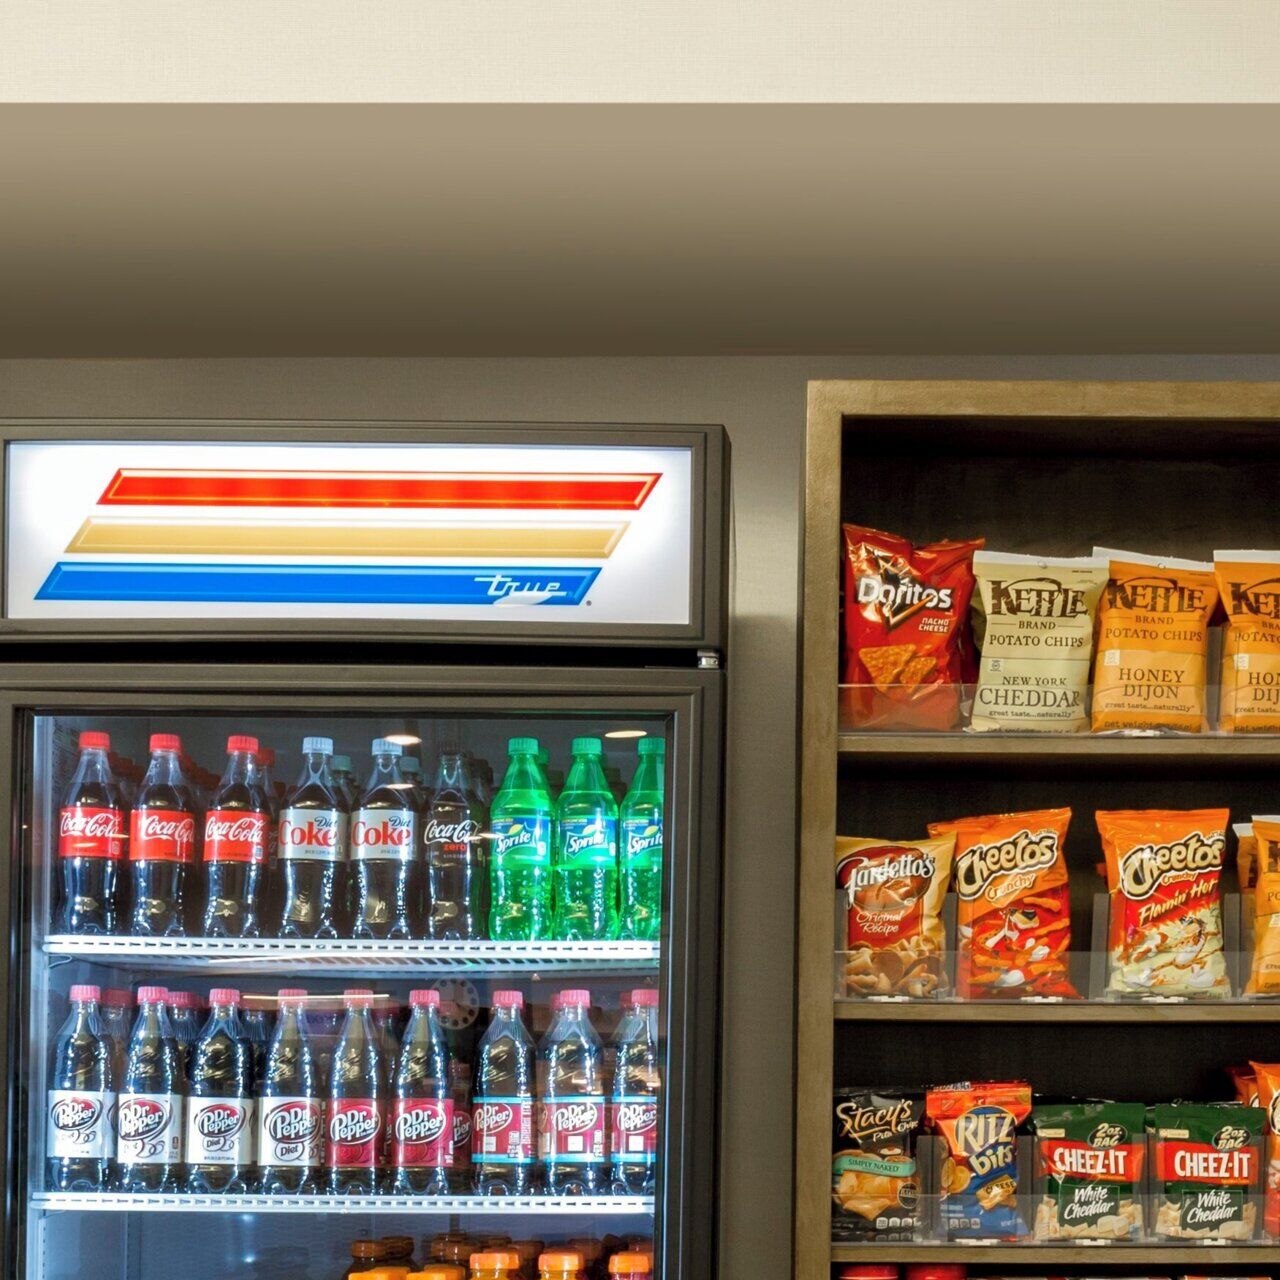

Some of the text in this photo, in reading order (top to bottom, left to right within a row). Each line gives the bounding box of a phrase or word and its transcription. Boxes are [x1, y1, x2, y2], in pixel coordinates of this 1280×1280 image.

[858, 576, 952, 609] Doritos
[1104, 578, 1207, 617] KETTLE
[918, 624, 949, 633] CHEESE
[1019, 620, 1056, 630] BRAND
[1105, 628, 1202, 641] POTATO CHIPS
[989, 635, 1084, 648] POTATO CHIPS
[1003, 676, 1067, 686] NEW YORK
[1119, 668, 1185, 682] HONEY
[979, 688, 1080, 708] CHEDDAR
[1124, 684, 1179, 698] DIJON
[278, 819, 337, 847] Coke
[351, 820, 410, 847] Coke
[497, 833, 531, 849] Sprite
[958, 833, 1056, 895] Cheetos
[985, 873, 1035, 901] Crunchy
[1191, 880, 1218, 900] Hot
[857, 911, 905, 925] Original
[860, 923, 899, 934] Recipe
[396, 1111, 445, 1141] Pepper
[836, 1099, 913, 1137] Stacy's
[956, 1113, 1014, 1150] RITZ
[279, 1145, 299, 1157] Diet
[970, 1145, 1014, 1176] bits
[1053, 1147, 1127, 1174] CHEEZ-IT
[1174, 1150, 1251, 1178] CHEEZ-IT
[1074, 1186, 1108, 1202] White
[1197, 1191, 1232, 1208] White
[1064, 1200, 1115, 1220] Cheddar
[1187, 1204, 1237, 1223] Cheddar
